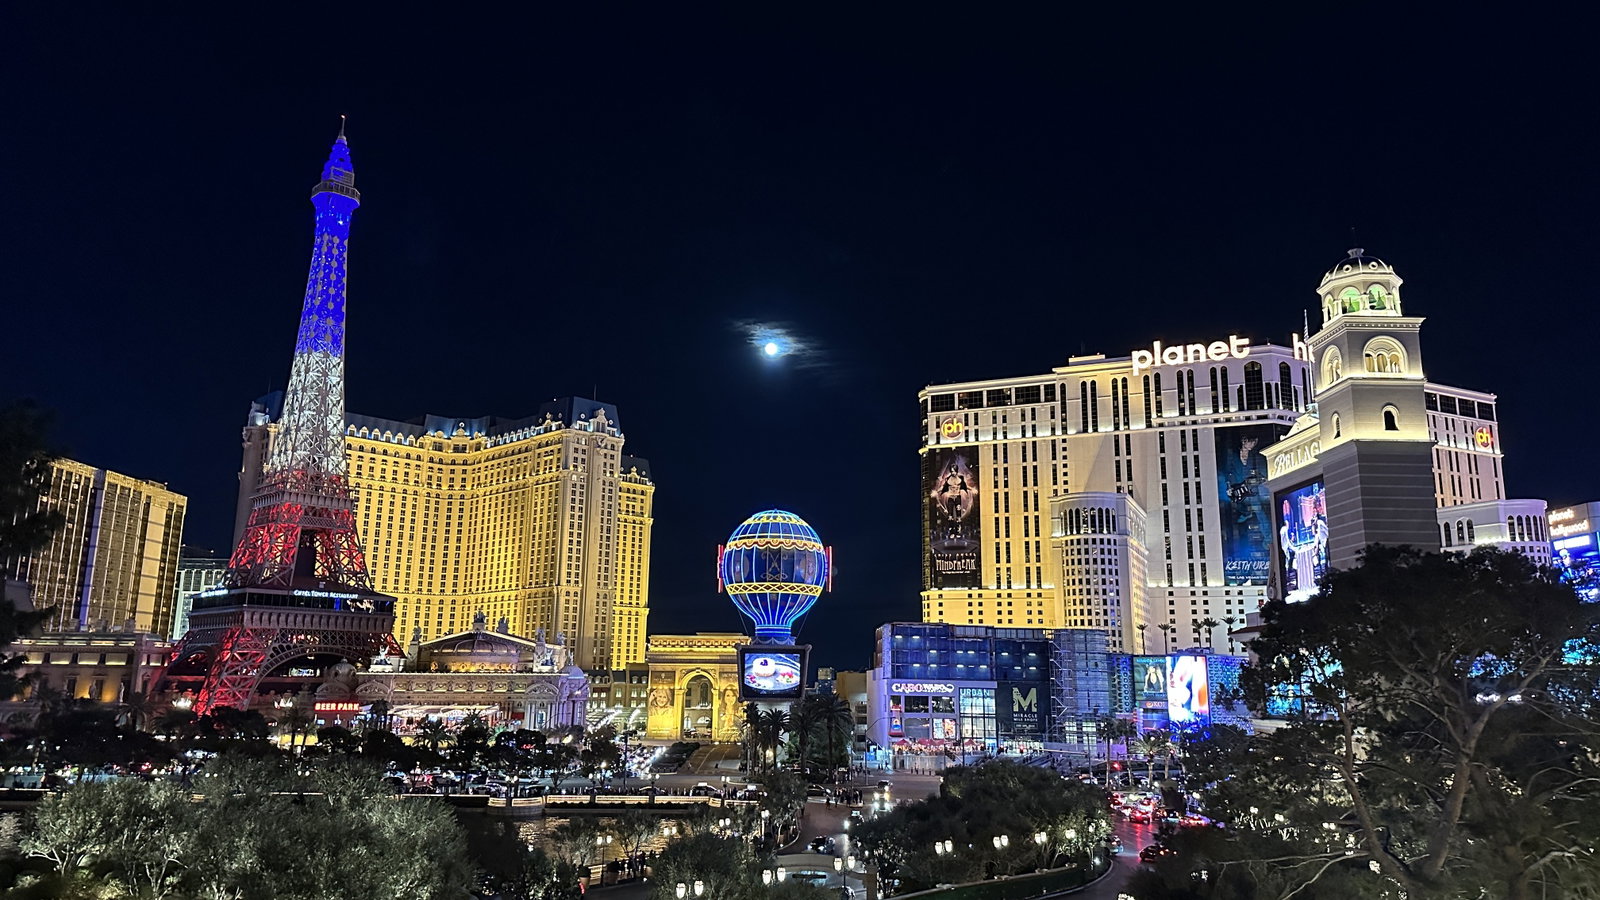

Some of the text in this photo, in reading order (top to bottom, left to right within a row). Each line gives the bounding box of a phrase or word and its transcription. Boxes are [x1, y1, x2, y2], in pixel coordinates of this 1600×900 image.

[1131, 335, 1250, 376] planet
[944, 418, 962, 435] ph
[1226, 560, 1251, 570] KEITH
[892, 683, 923, 694] CABO
[314, 702, 359, 710] BEER PARK
